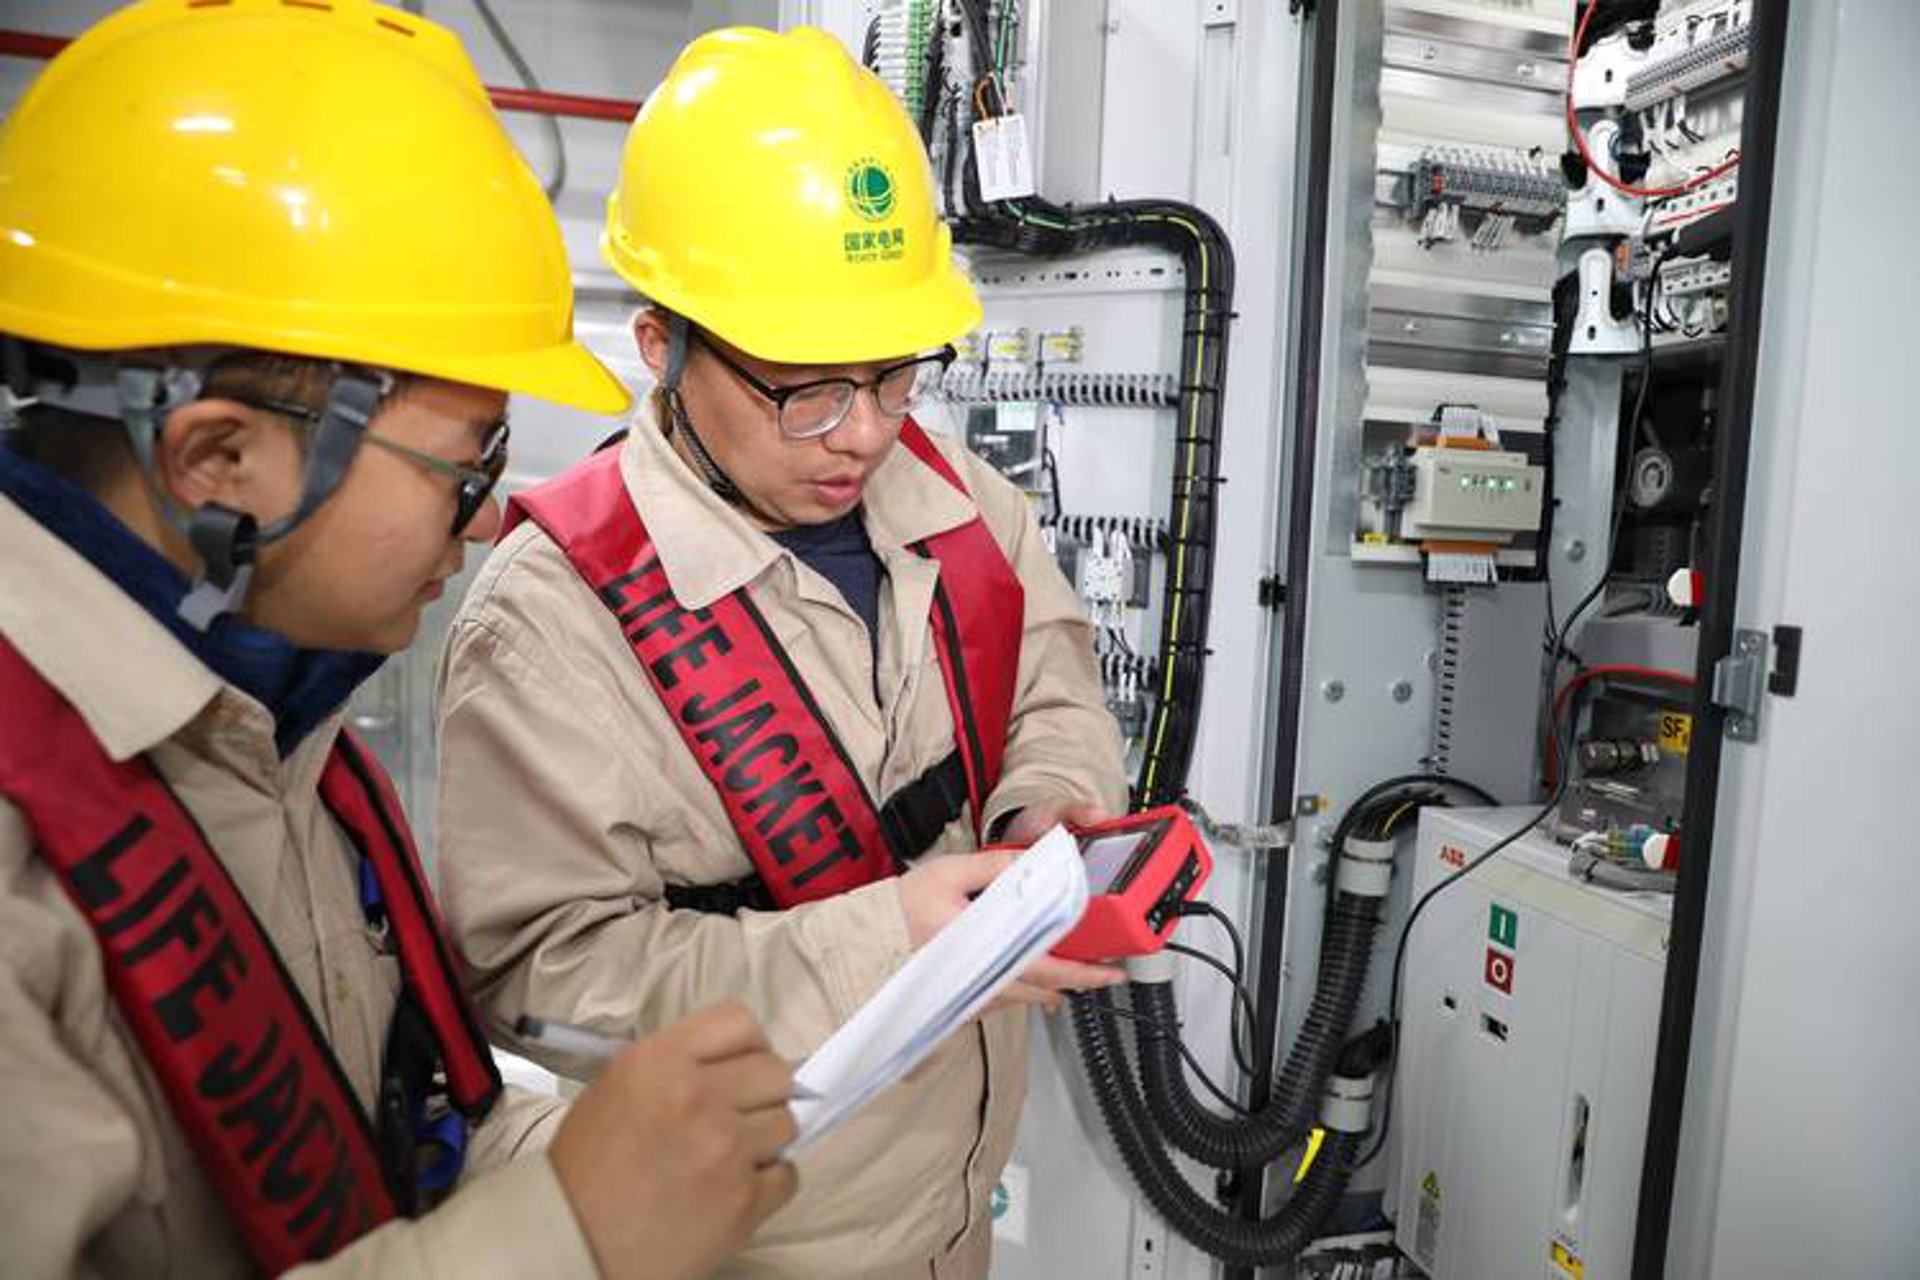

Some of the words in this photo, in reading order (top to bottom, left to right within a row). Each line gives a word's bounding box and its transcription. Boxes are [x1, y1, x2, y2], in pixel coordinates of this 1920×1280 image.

[599, 556, 733, 691] LIFE
[680, 678, 862, 888] JACKET
[69, 813, 248, 1043] LIFE
[196, 1020, 372, 1260] JACK
